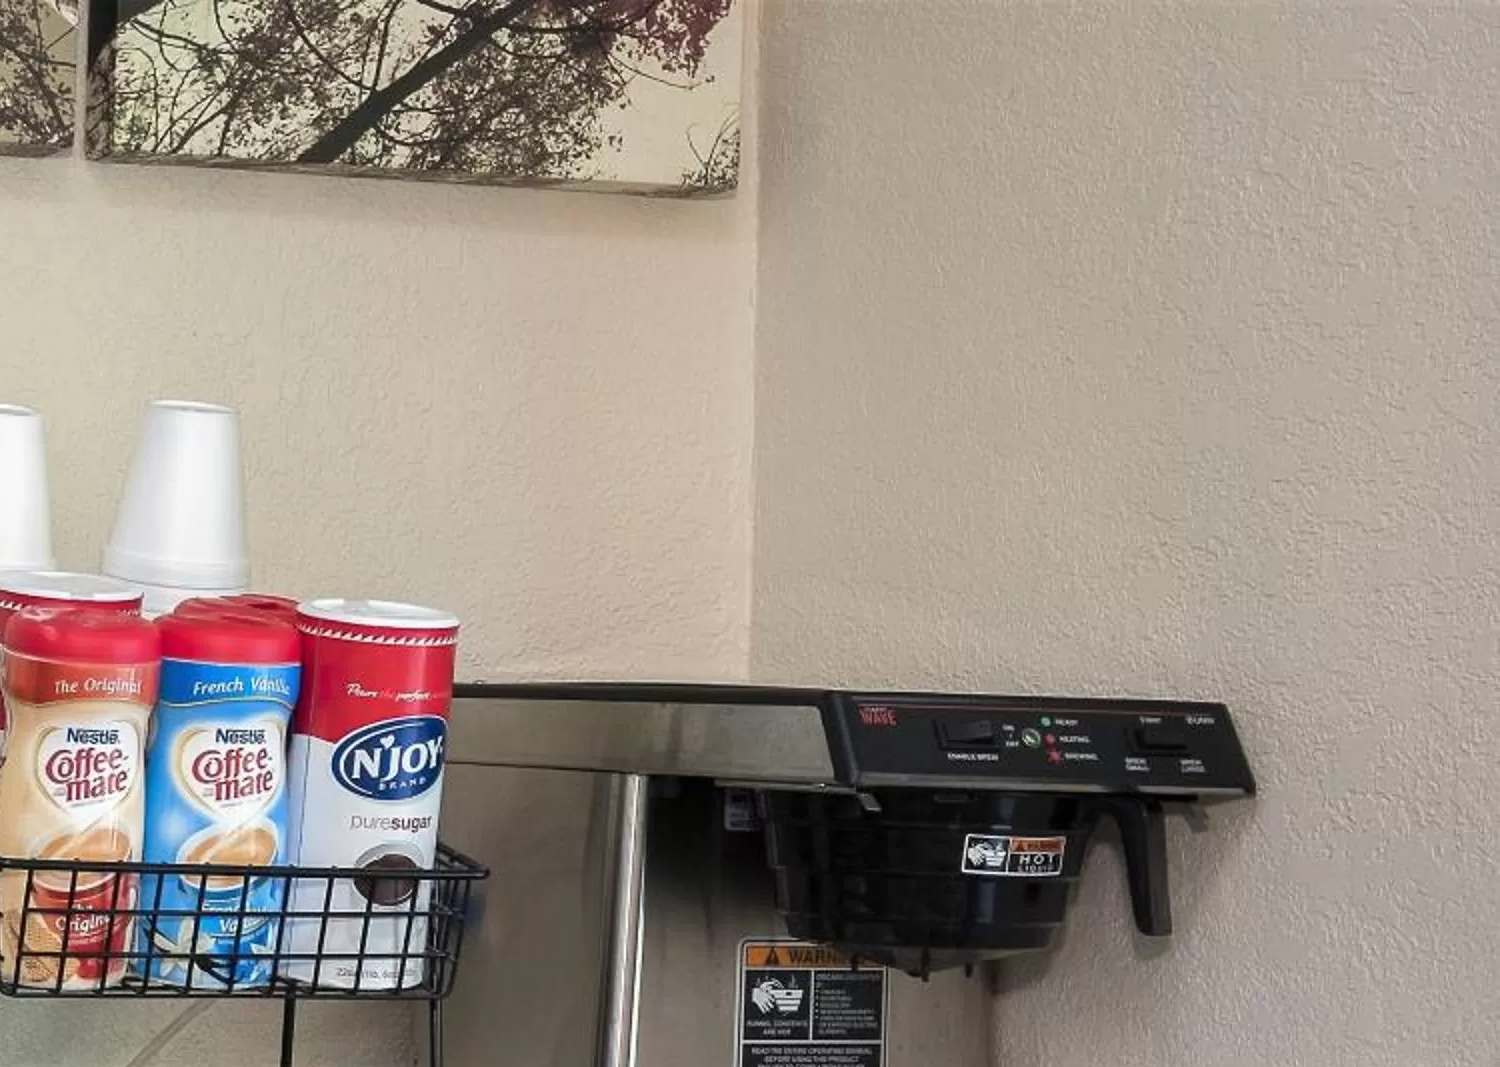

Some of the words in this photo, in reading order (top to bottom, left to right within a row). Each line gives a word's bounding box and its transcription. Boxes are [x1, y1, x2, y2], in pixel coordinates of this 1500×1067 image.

[54, 679, 79, 694] The
[84, 676, 143, 695] Original
[193, 676, 245, 696] French
[67, 770, 128, 801] mate
[215, 770, 273, 801] mate
[378, 777, 427, 791] BRAND
[1019, 854, 1055, 865] HOT
